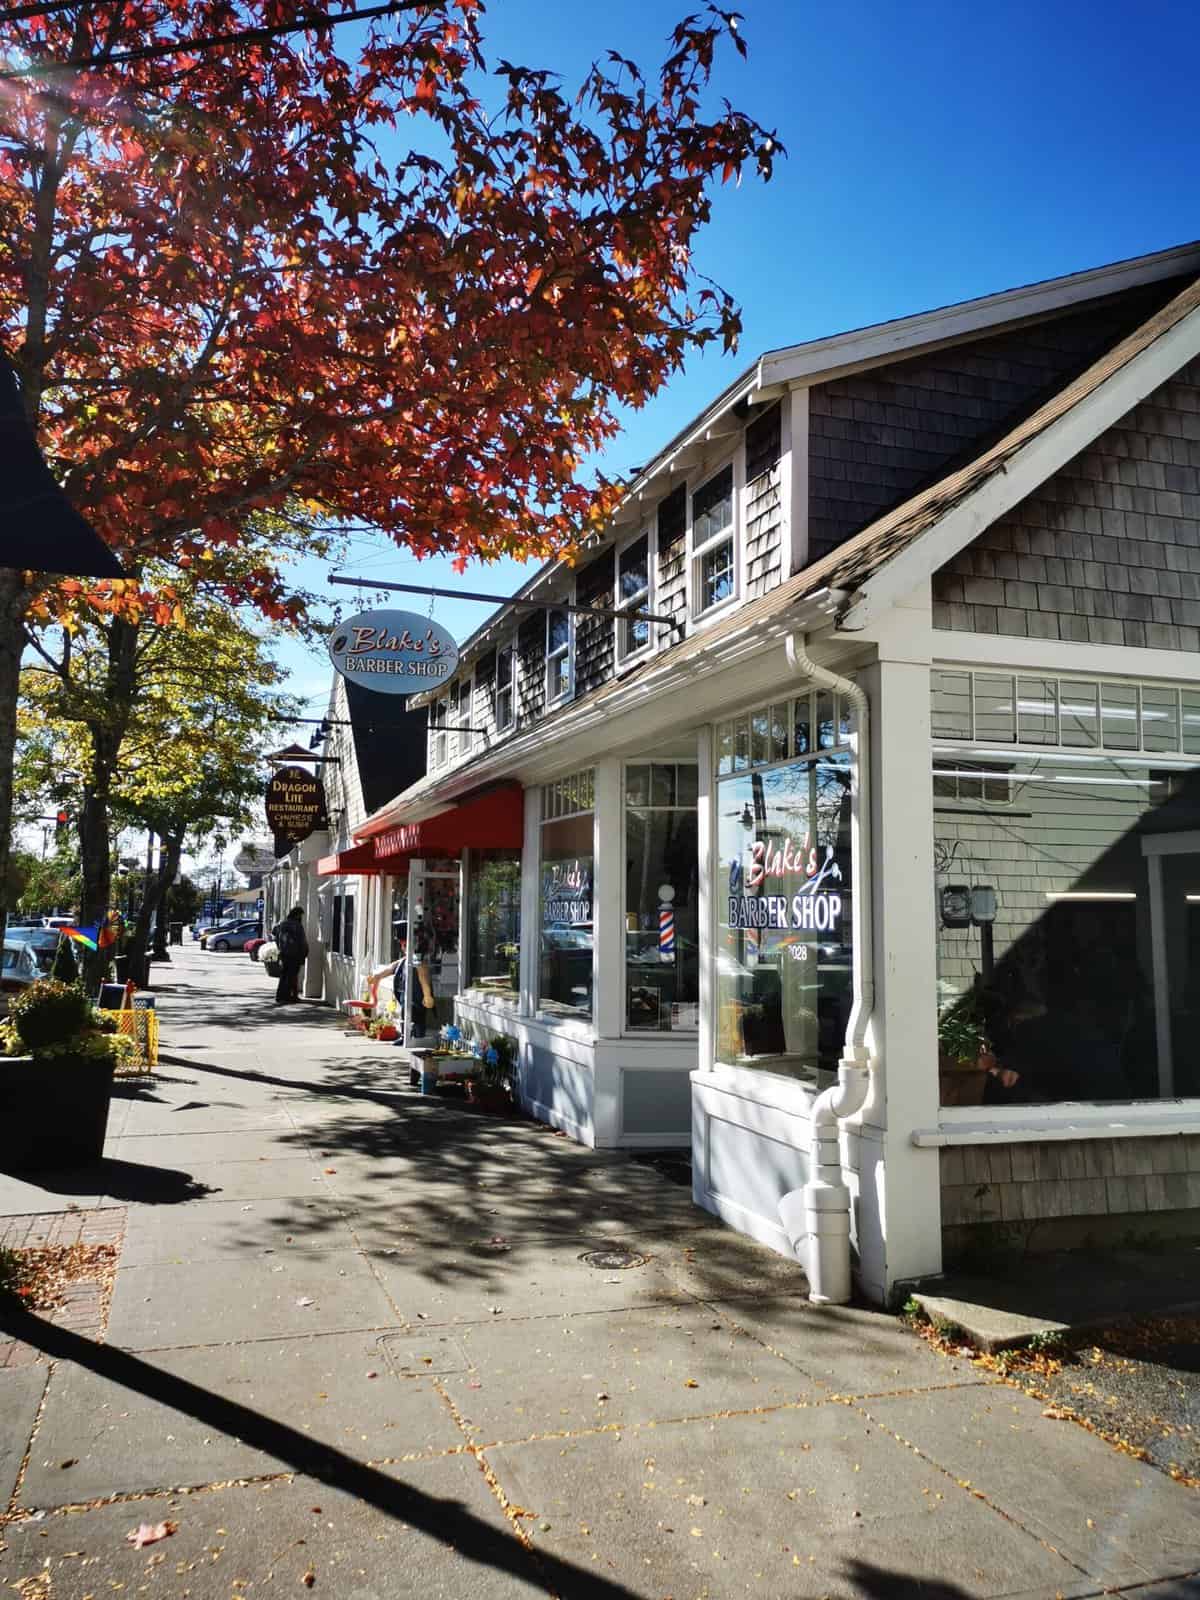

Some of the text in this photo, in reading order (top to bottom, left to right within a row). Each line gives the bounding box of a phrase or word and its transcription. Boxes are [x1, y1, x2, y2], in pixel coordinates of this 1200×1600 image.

[347, 626, 440, 656] Blake's
[345, 656, 449, 677] BARBER SHOP
[748, 831, 818, 888] Blake's
[569, 900, 590, 921] SHOP
[728, 895, 842, 930] BARBER SHOP
